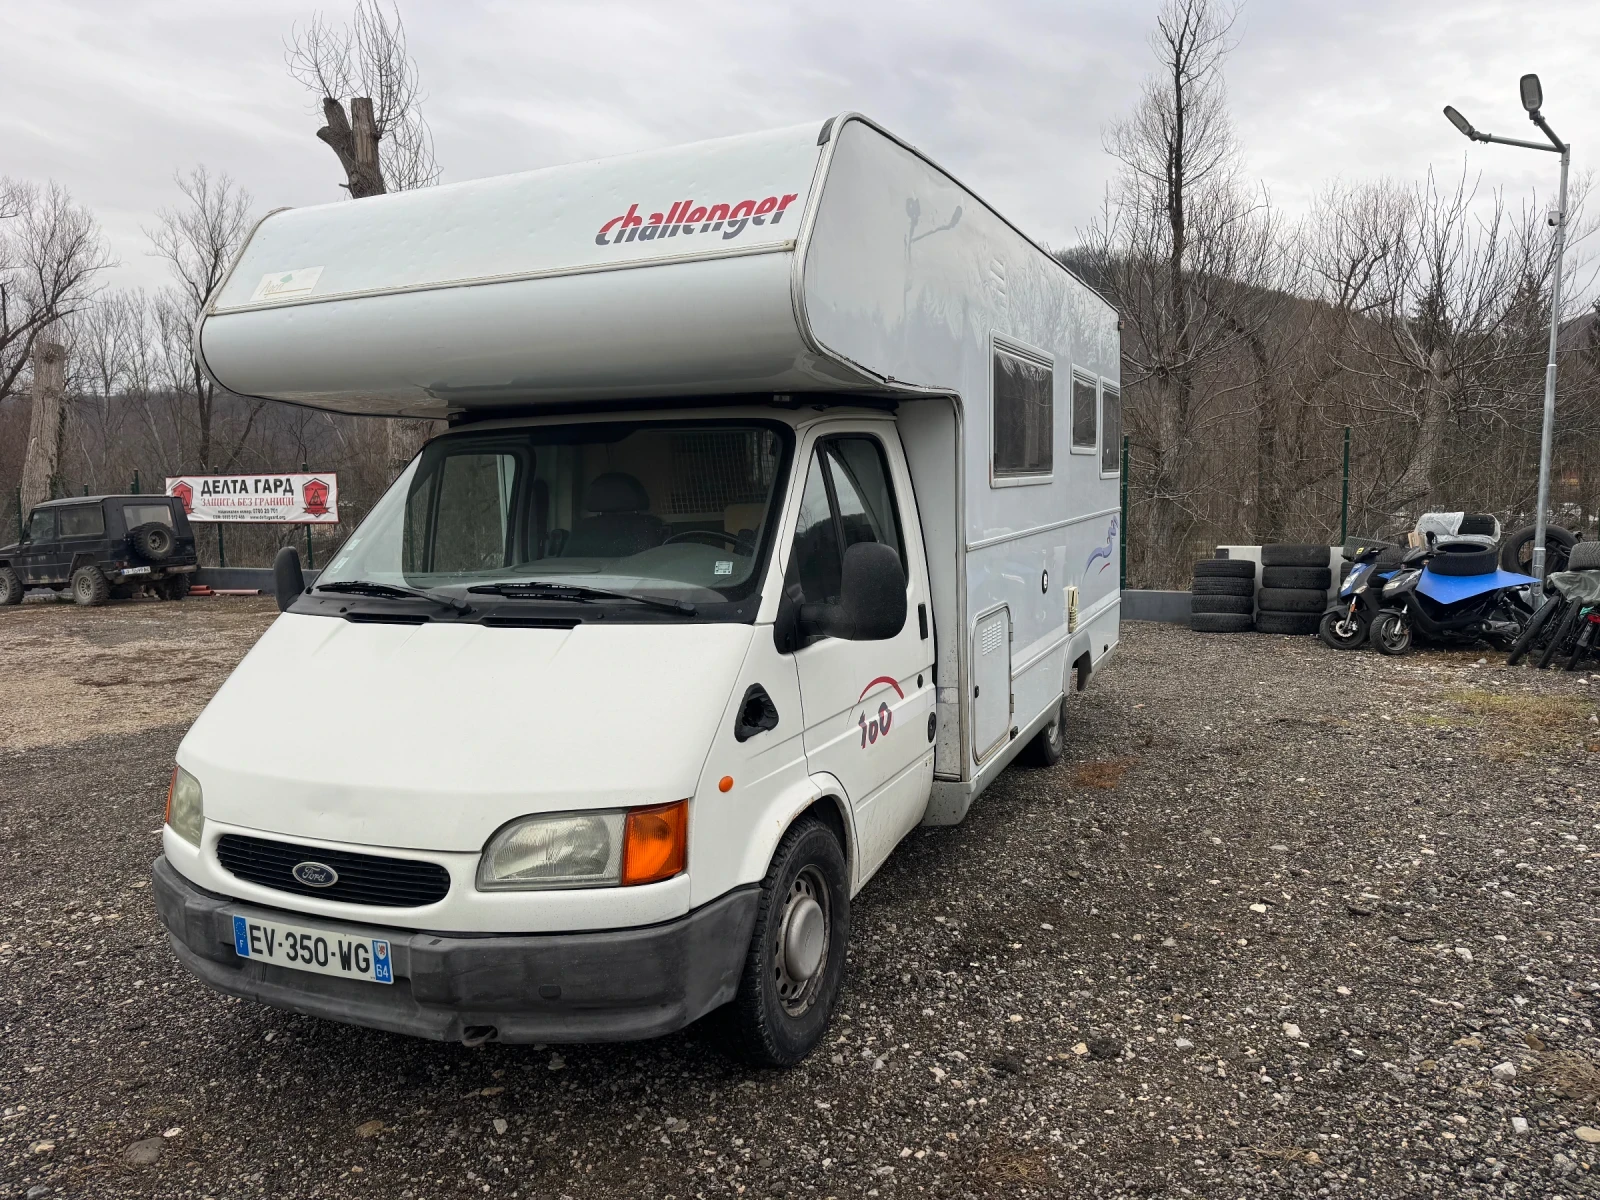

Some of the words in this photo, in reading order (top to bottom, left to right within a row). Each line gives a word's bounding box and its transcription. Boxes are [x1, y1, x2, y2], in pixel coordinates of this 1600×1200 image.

[201, 479, 249, 497] ДЕЛТА
[254, 478, 294, 496] ГАРД
[201, 498, 236, 508] ЗАЩИТА
[237, 498, 253, 507] БЕЗ
[254, 497, 295, 507] ГРАНИЦИ
[858, 701, 893, 750] 100
[302, 866, 326, 881] Ford
[239, 939, 244, 948] F
[249, 924, 371, 973] EV-350-WG
[376, 963, 389, 978] 64
